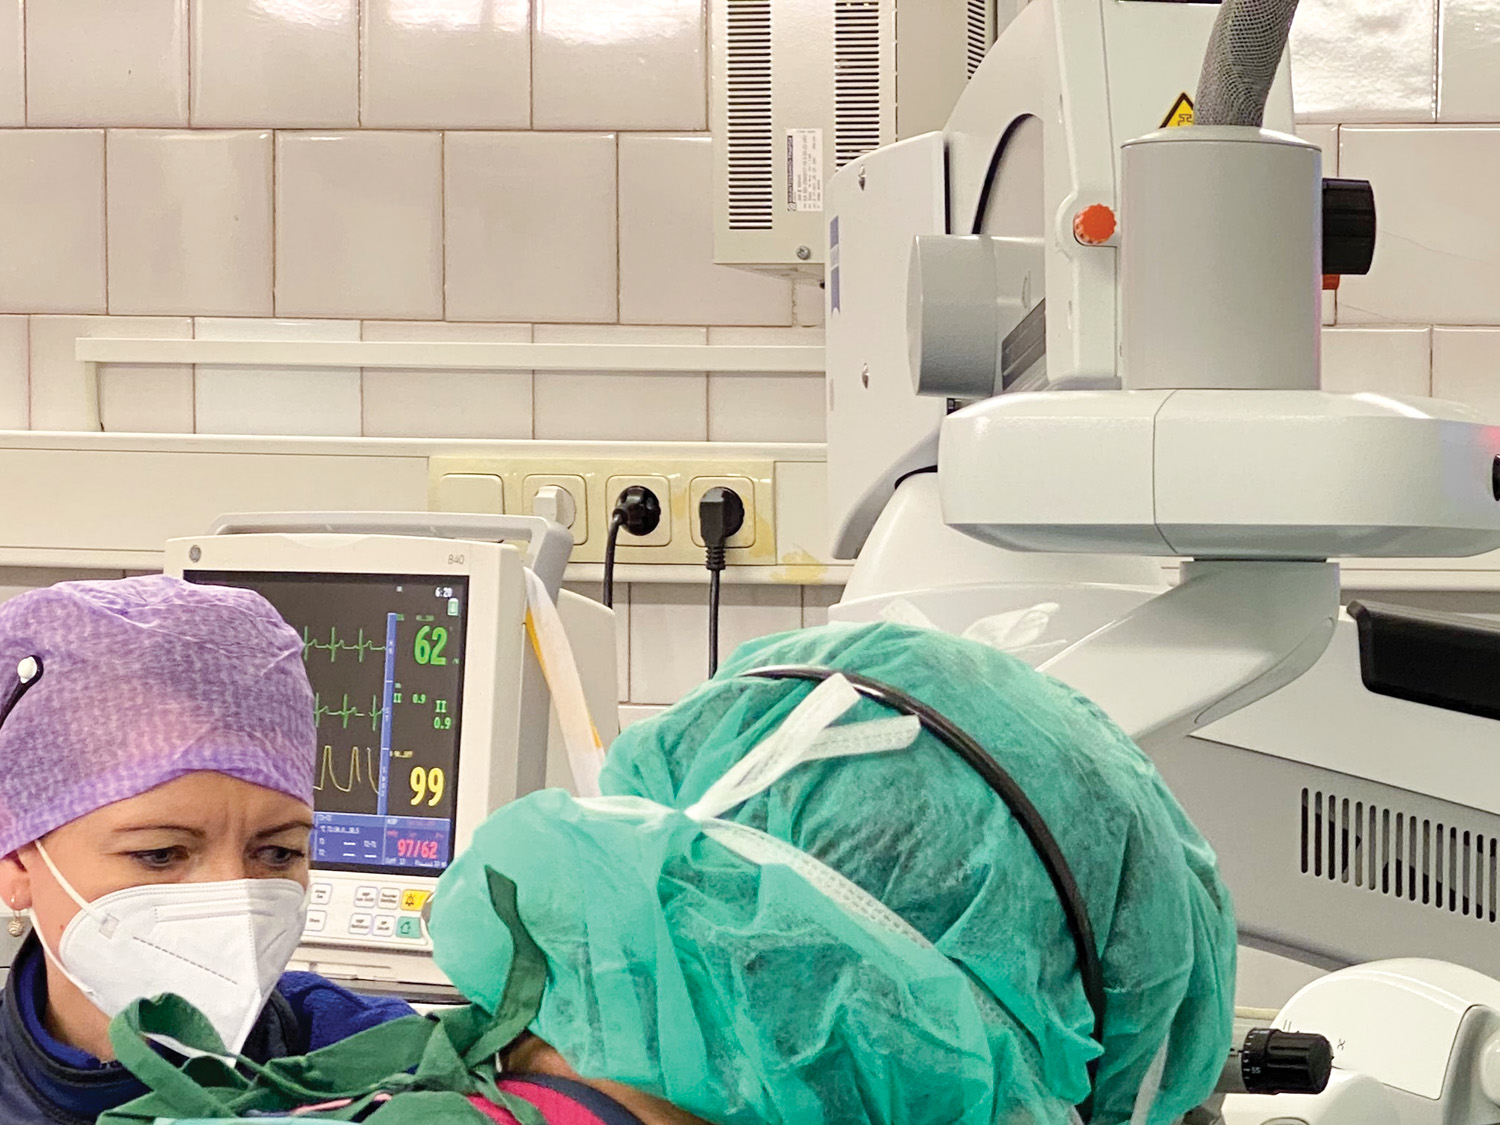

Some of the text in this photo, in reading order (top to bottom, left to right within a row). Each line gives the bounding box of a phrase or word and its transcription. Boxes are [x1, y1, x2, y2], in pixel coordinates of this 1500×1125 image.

[448, 554, 465, 565] B40
[414, 625, 448, 666] 62
[433, 716, 452, 730] 0.9
[409, 766, 445, 807] 99
[397, 838, 439, 859] 97/62
